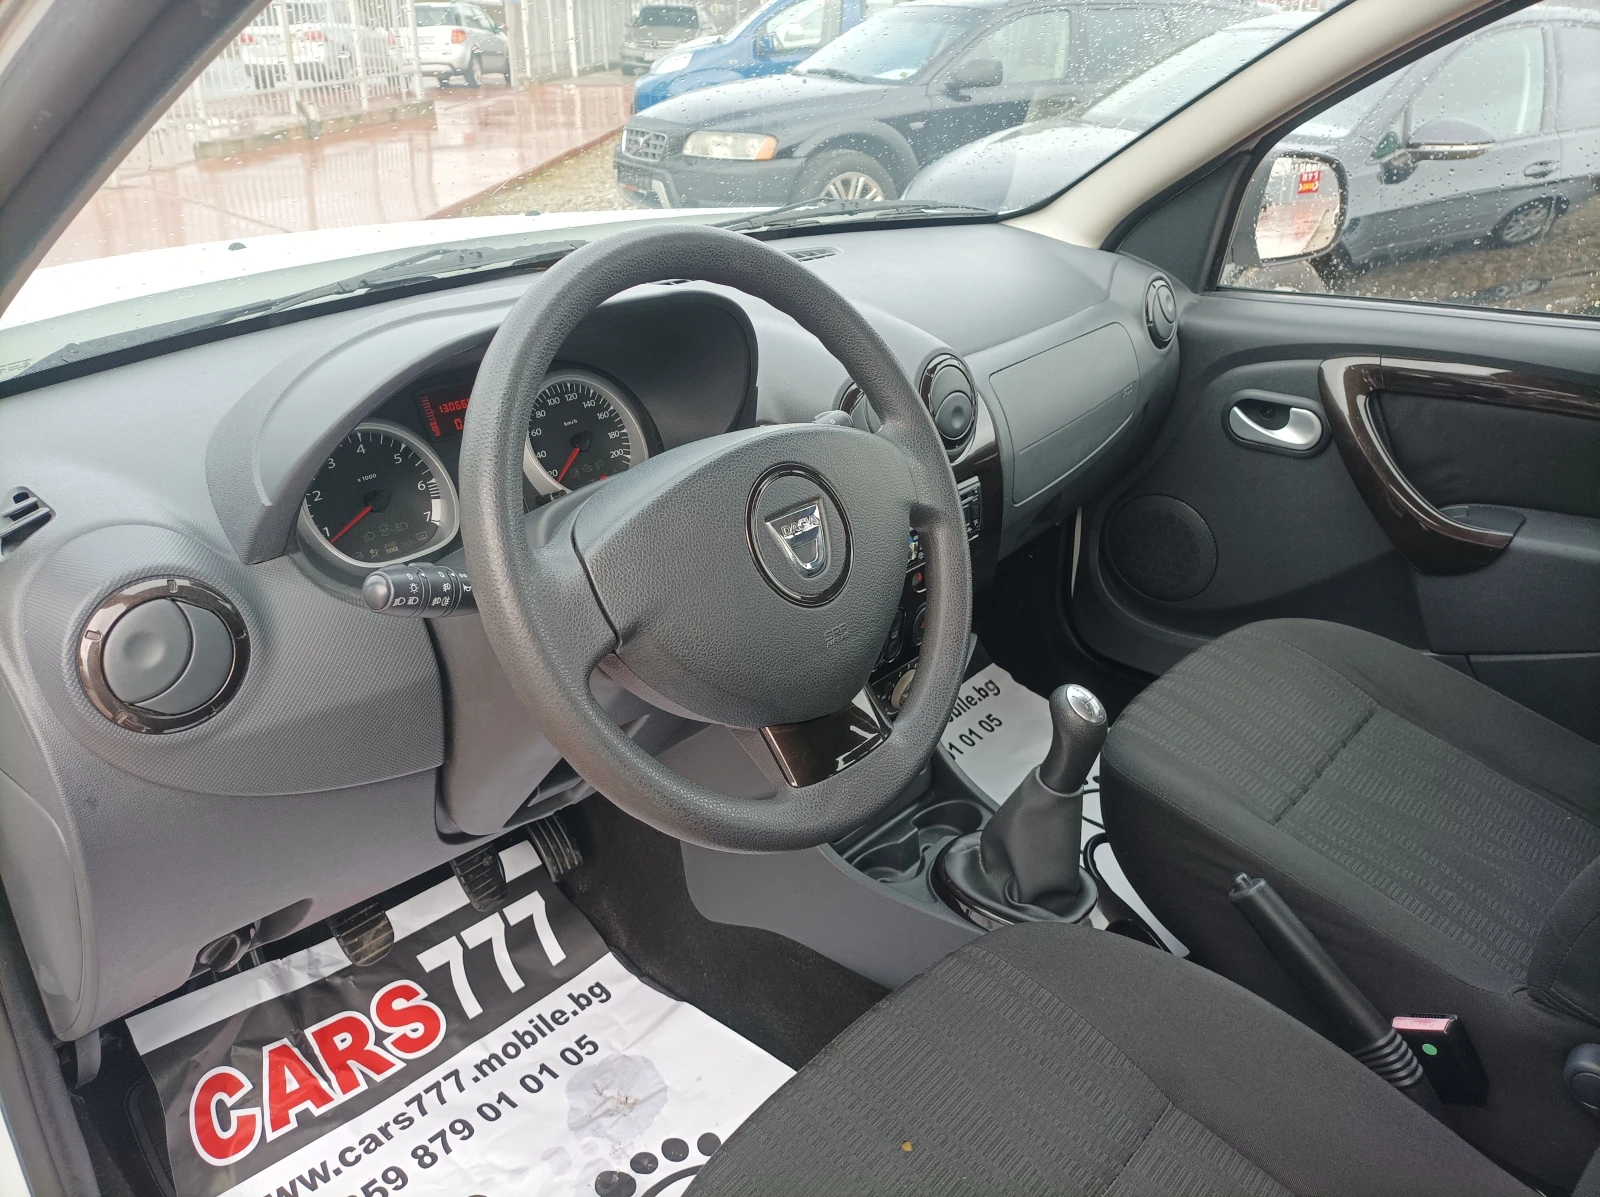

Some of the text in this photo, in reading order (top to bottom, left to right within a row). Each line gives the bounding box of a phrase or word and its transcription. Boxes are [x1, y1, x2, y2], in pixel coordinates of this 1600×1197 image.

[546, 396, 560, 407] 100
[564, 392, 578, 402] 120
[439, 398, 471, 414] 13066
[582, 399, 596, 409] 140
[535, 409, 546, 419] 80
[596, 410, 610, 420] 160
[563, 418, 578, 426] km/h
[531, 427, 542, 437] 60
[607, 430, 620, 439] 180
[356, 443, 366, 454] 4
[609, 448, 624, 459] 200
[393, 453, 402, 464] 5
[536, 450, 547, 459] 40
[327, 458, 336, 469] 3
[417, 481, 426, 491] 6
[312, 490, 323, 502] 2
[422, 511, 431, 523] 7
[322, 526, 331, 538] 1
[959, 728, 984, 747] 01
[978, 713, 1003, 733] 05
[190, 890, 567, 1166] CARS 777
[410, 1119, 476, 1170] 879
[479, 1090, 520, 1122] 01
[519, 1060, 561, 1093] 01
[559, 1034, 601, 1067] 05
